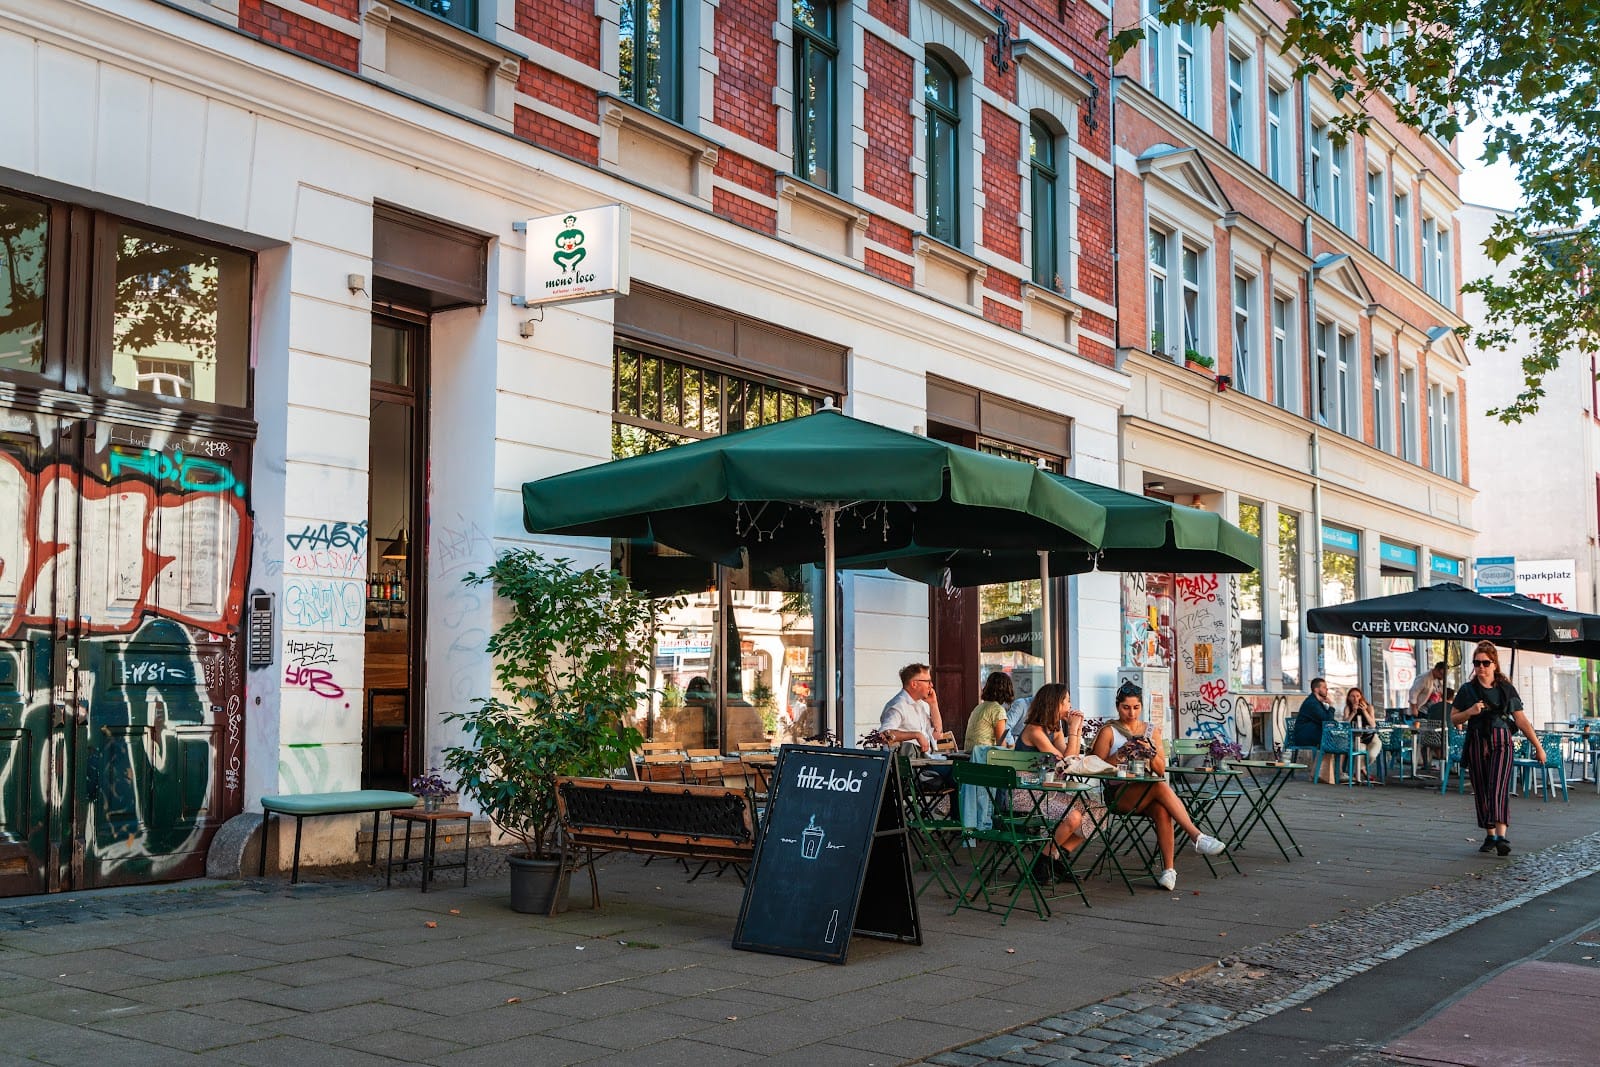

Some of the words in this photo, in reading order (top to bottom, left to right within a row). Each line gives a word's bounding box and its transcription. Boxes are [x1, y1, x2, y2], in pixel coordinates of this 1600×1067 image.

[545, 277, 572, 289] mono
[575, 271, 595, 284] loco
[1517, 571, 1571, 582] nparkplatz
[1352, 619, 1391, 633] CAFFÈ
[1393, 621, 1469, 634] VERGNANO
[1471, 624, 1503, 636] 1882
